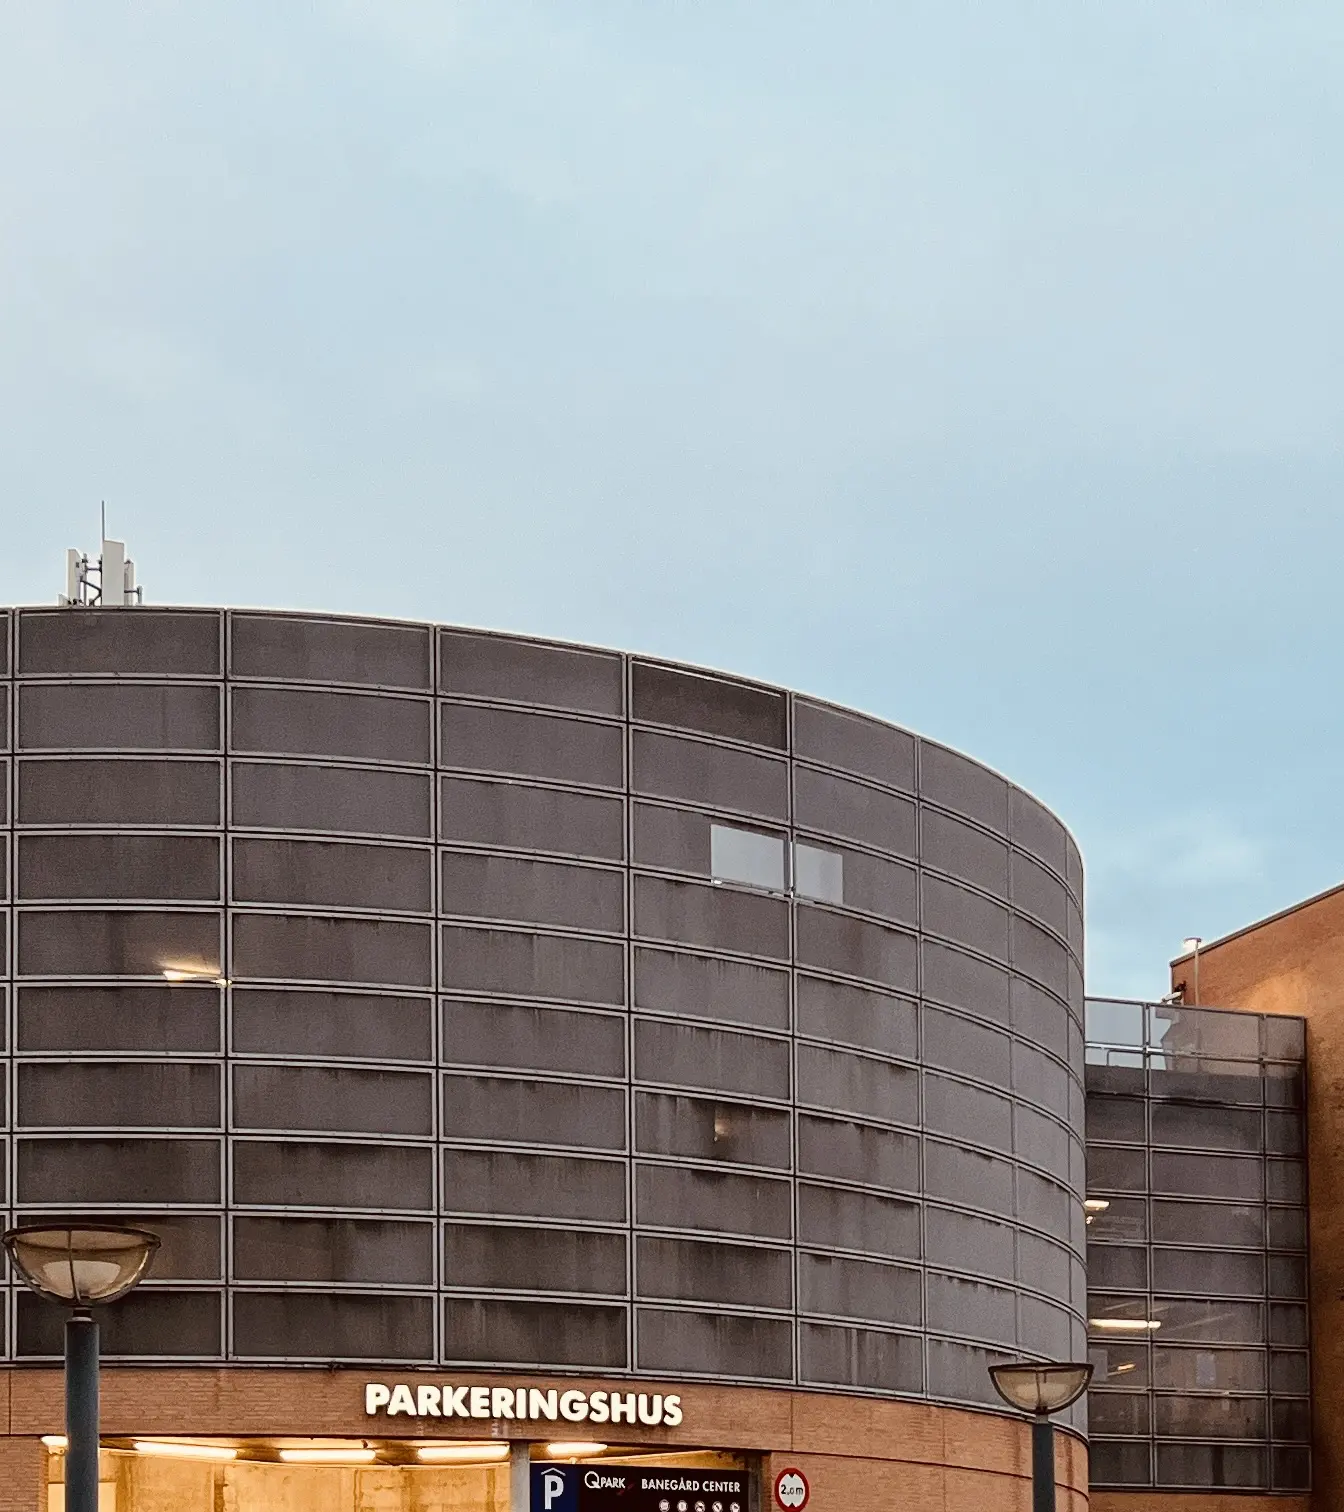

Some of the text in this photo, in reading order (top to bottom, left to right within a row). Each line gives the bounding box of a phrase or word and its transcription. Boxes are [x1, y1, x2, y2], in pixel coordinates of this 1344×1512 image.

[365, 1383, 683, 1426] PARKERINGSHUS
[544, 1474, 564, 1510] P
[641, 1476, 741, 1493] BANEGÅRD CENTER
